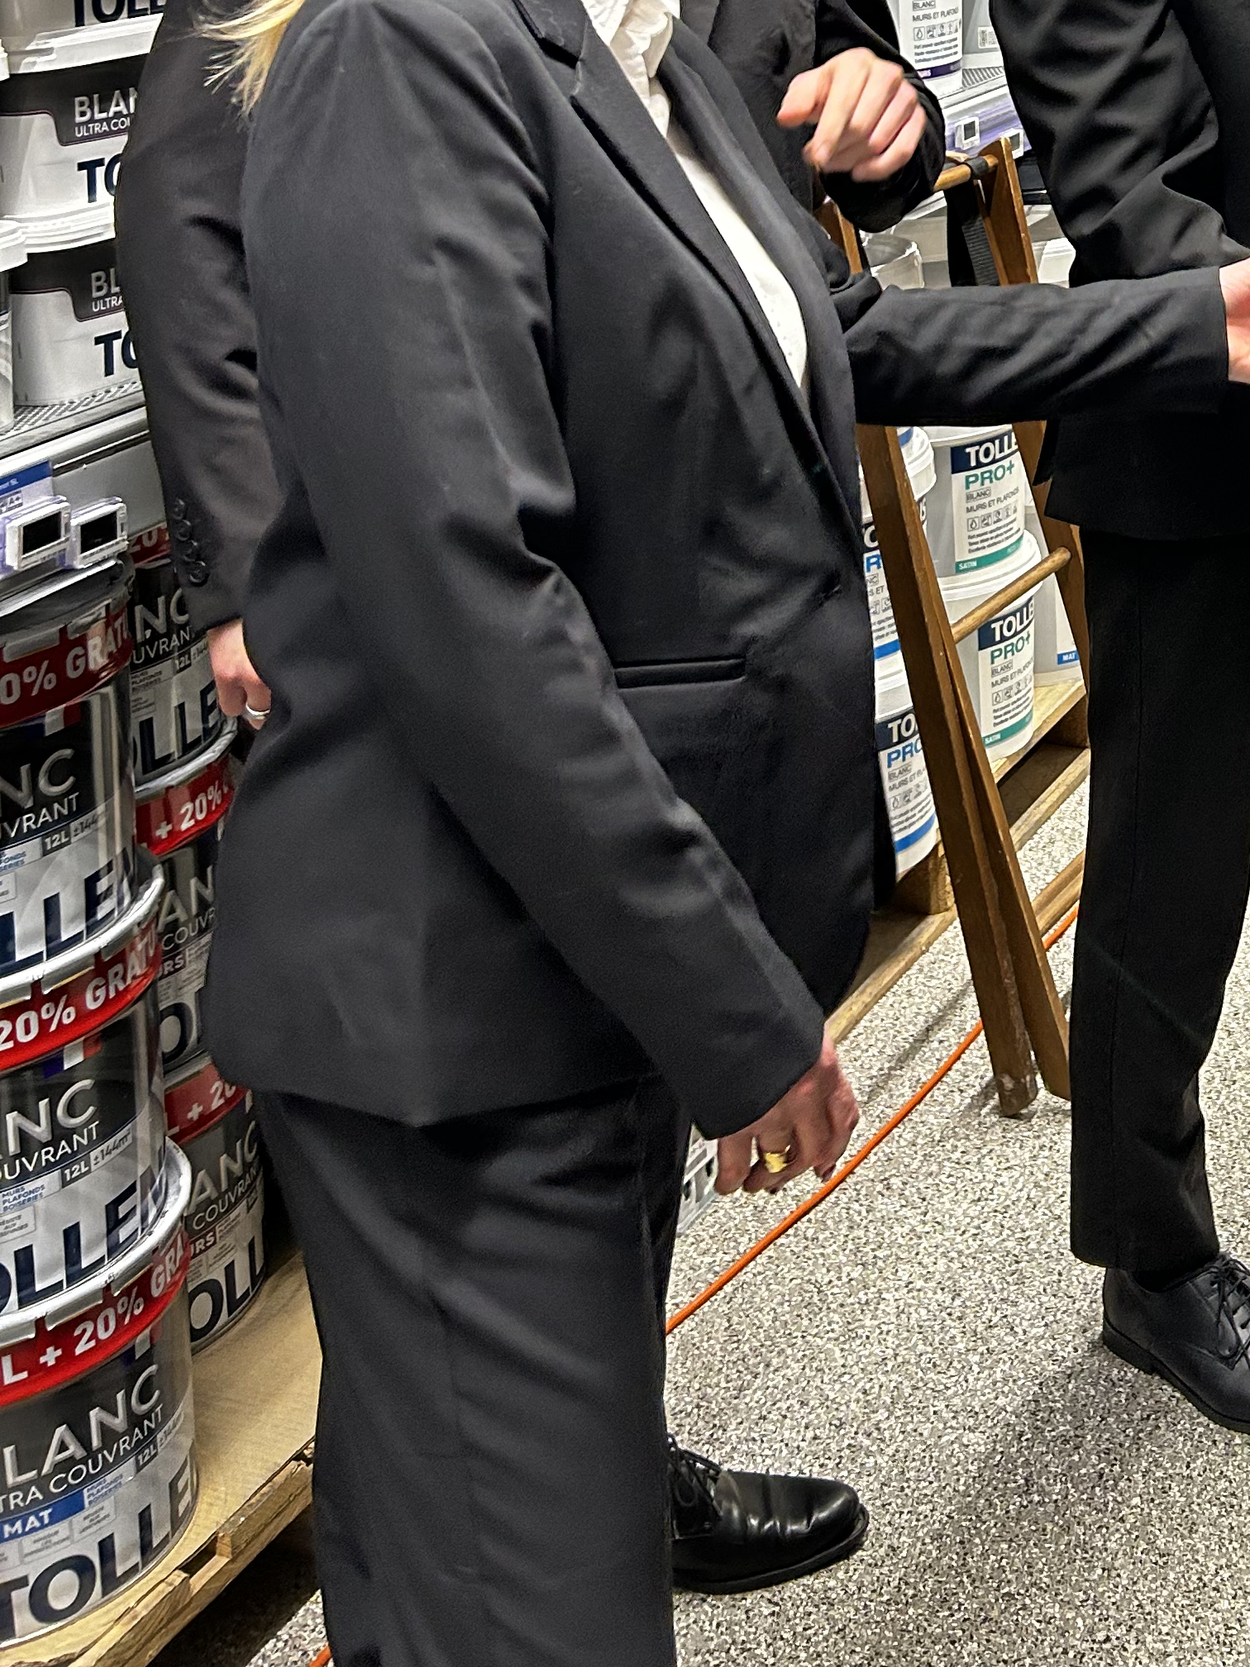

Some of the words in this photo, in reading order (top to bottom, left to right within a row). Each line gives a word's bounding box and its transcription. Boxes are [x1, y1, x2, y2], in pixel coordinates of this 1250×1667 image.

[913, 1, 935, 10] BLANC
[75, 119, 109, 137] ULTRA
[965, 460, 1014, 490] PRO+
[966, 488, 990, 501] BLANC
[966, 501, 986, 514] MURS
[991, 602, 1034, 642] TOLLE
[991, 631, 1031, 664] PRO+
[180, 781, 222, 832] 20%
[44, 831, 69, 850] 12L
[0, 994, 76, 1047] 20%
[64, 1159, 89, 1180] 12L
[2, 1187, 25, 1198] MURS
[2, 1185, 46, 1204] PLAFONDS
[73, 1287, 145, 1353] 20%
[3, 1364, 160, 1484] LANC
[49, 1403, 163, 1493] COUVRANT
[138, 1446, 157, 1465] 12L
[5, 1508, 53, 1538] MAT
